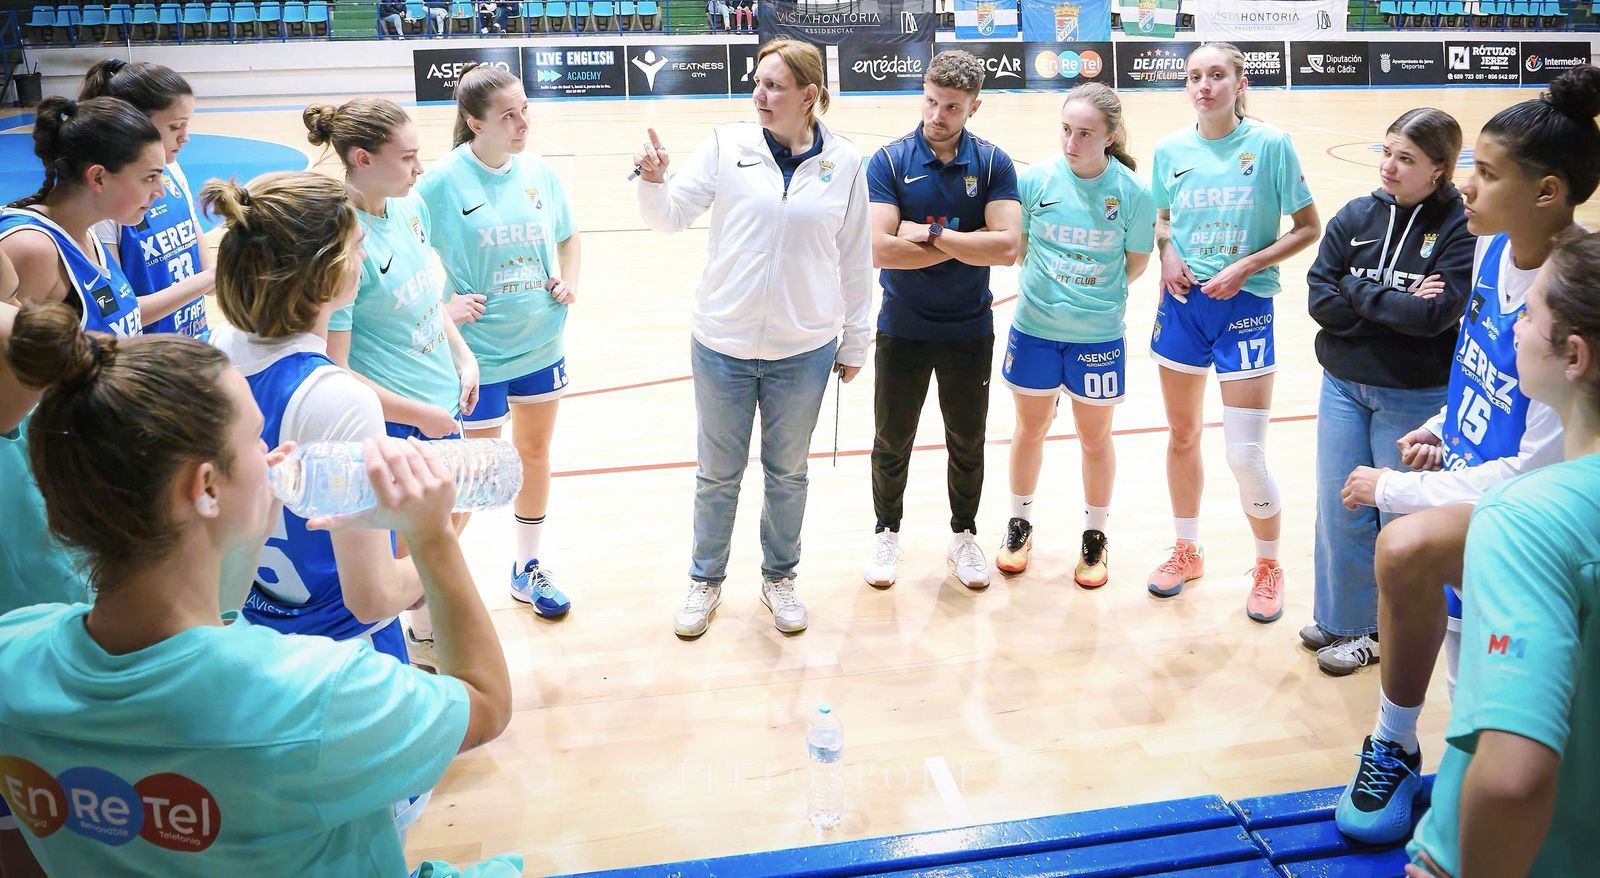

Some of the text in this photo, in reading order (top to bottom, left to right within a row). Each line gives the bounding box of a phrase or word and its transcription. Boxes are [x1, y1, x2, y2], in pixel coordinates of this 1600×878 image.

[776, 11, 881, 24] VISTAHONTORIA
[1243, 51, 1280, 61] XEREZ
[1472, 45, 1517, 56] RÓTULOS
[535, 50, 615, 66] LIVE ENGLISH
[1133, 58, 1184, 70] DESAFIO
[1244, 61, 1281, 69] ROOKIES
[1326, 54, 1362, 65] Diputación
[1480, 56, 1509, 66] JEREZ
[1544, 57, 1587, 67] Intermedia2
[672, 62, 724, 70] FEATNESS
[851, 54, 923, 81] enrédate
[1326, 64, 1356, 74] de Cádiz
[567, 71, 602, 80] ACADEMY
[1140, 71, 1178, 82] FIT CLUB
[1178, 185, 1254, 210] XEREZ
[140, 219, 197, 261] XEREZ
[1043, 222, 1116, 249] XEREZ
[1190, 229, 1248, 244] DESAFIO
[167, 251, 196, 287] 33
[502, 280, 543, 294] FIT CLUB
[1073, 276, 1097, 286] CLUB
[1227, 313, 1273, 333] ASENCIO
[1077, 348, 1121, 363] ASENCIO
[1237, 337, 1267, 371] 17
[1084, 370, 1119, 399] 00
[1457, 384, 1492, 446] 15
[71, 788, 131, 826] Re
[142, 796, 210, 837] Tel
